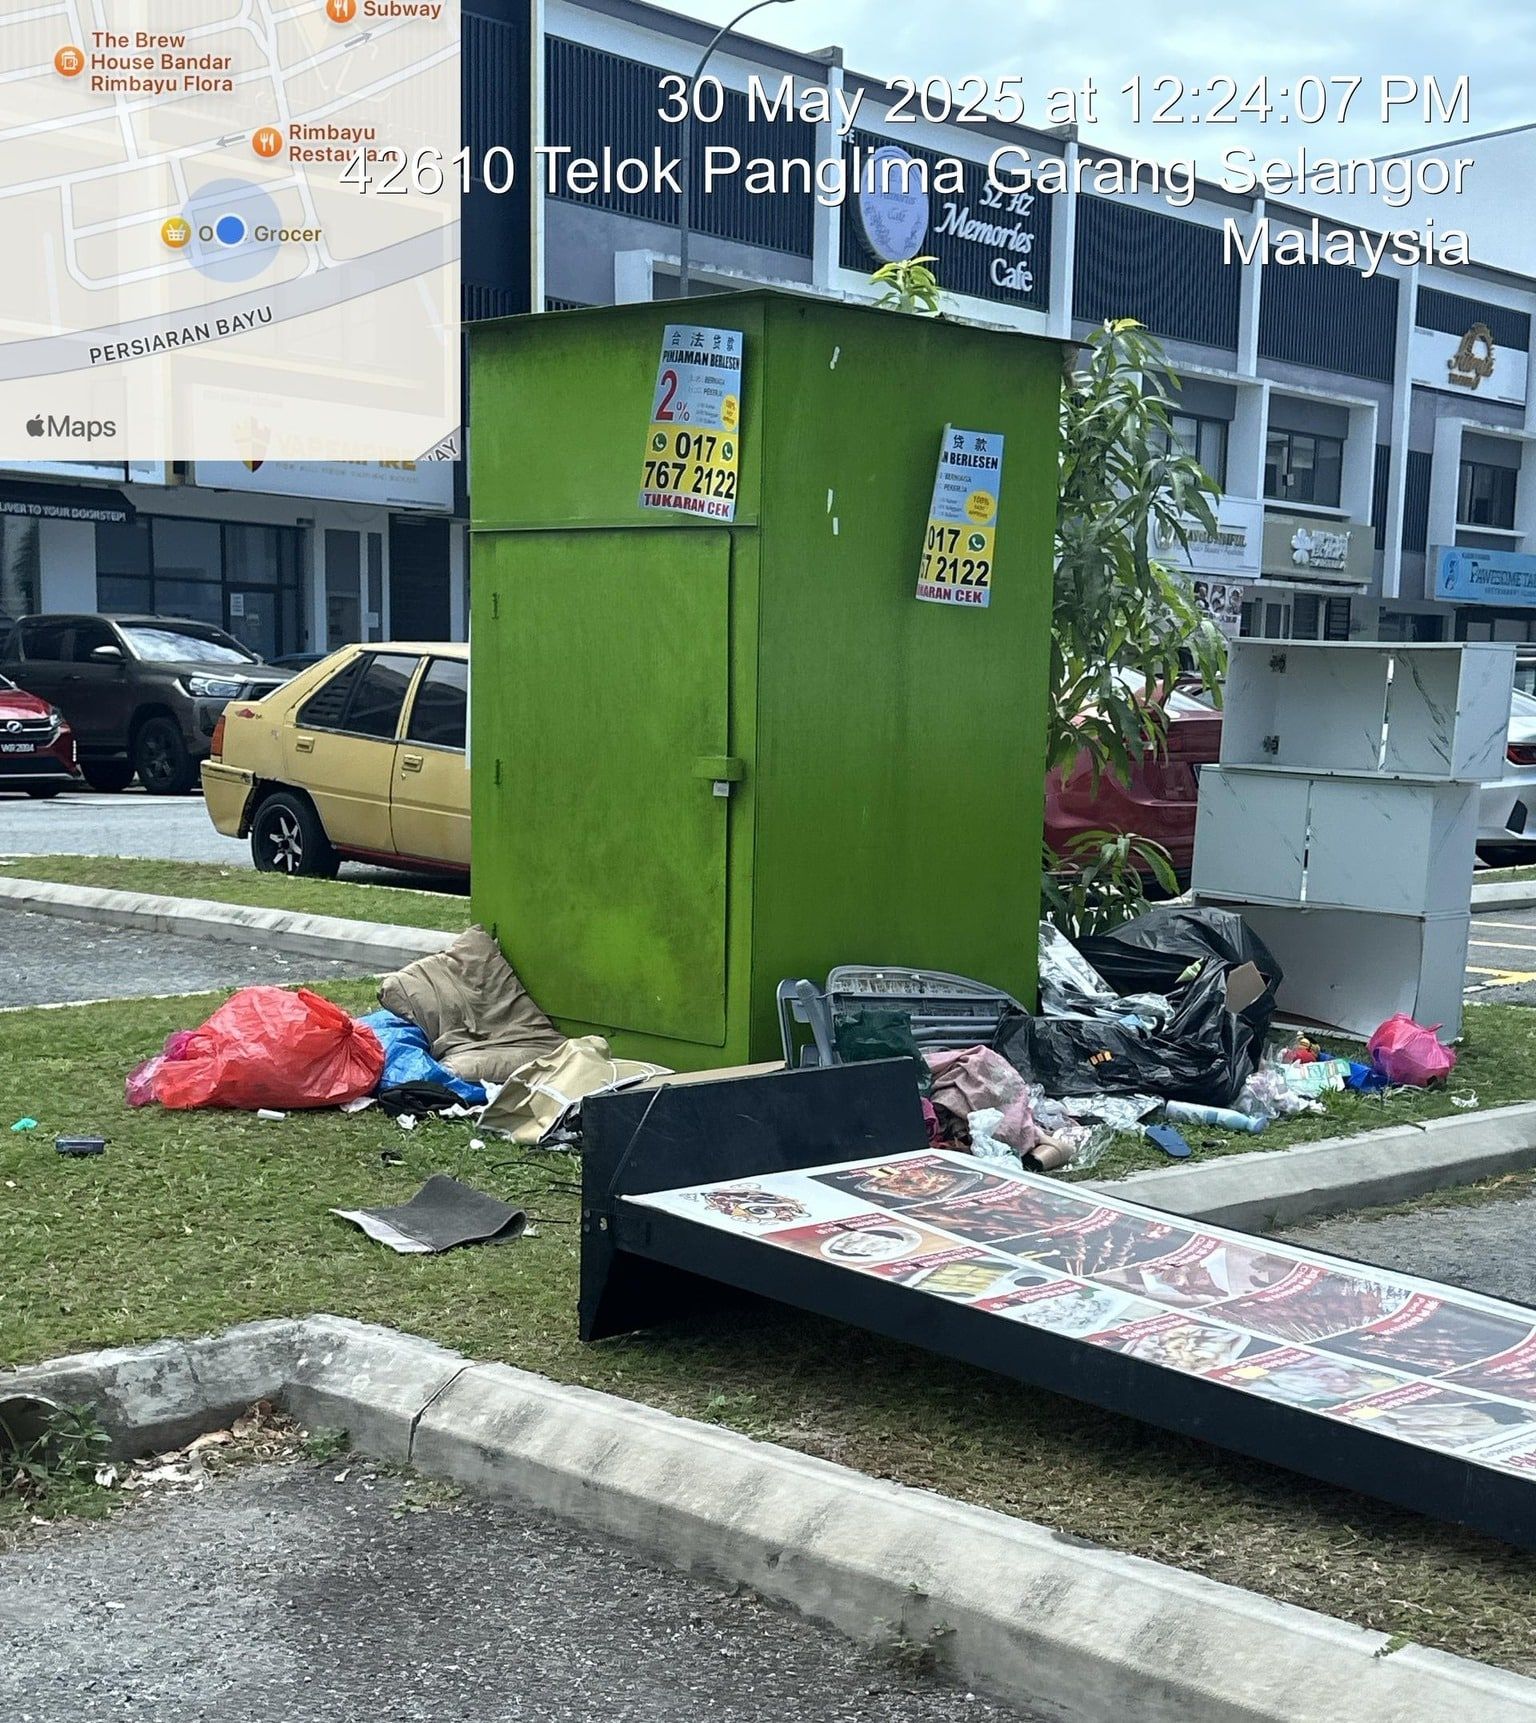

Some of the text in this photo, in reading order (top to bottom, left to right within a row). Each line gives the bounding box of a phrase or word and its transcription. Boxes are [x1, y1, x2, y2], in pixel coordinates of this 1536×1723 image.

[933, 202, 1035, 254] Memories
[990, 257, 1034, 292] Cafe
[710, 352, 741, 371] BERLESEN
[675, 432, 717, 463] 017
[952, 434, 988, 452] 贷款
[950, 452, 999, 470] BERLESEN
[644, 461, 736, 499] 767 2122
[28, 503, 41, 515] TO
[644, 493, 730, 517] TUKARAN CEK
[928, 525, 961, 554] 017
[935, 556, 990, 587] 2122
[955, 589, 983, 604] CEK
